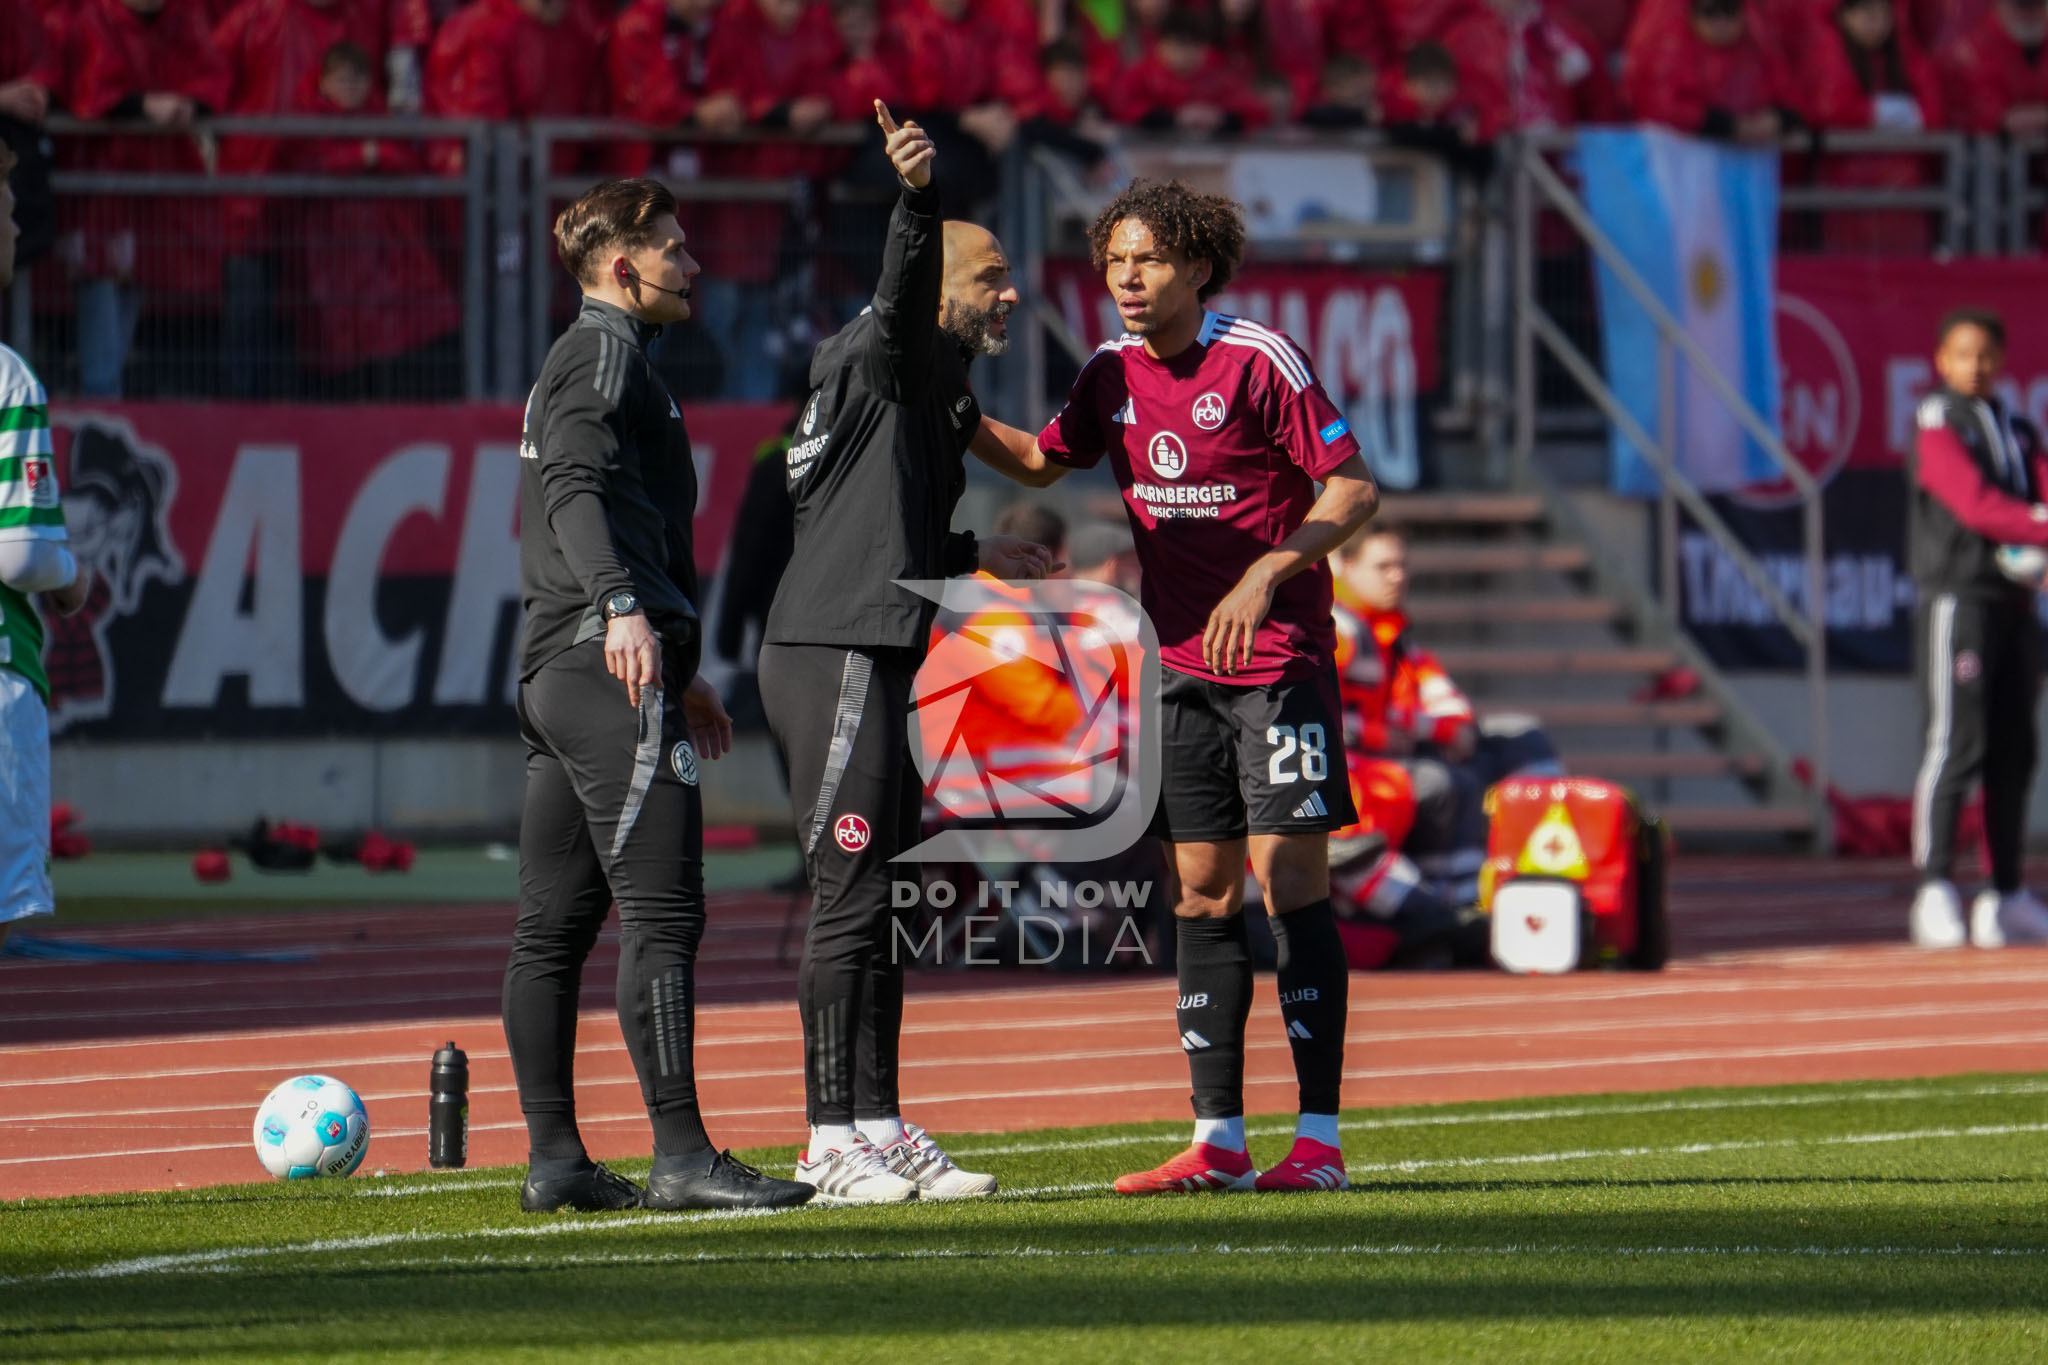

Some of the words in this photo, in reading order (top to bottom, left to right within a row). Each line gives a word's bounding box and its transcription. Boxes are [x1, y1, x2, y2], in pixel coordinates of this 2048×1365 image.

[1196, 407, 1222, 422] FCN
[1146, 504, 1219, 519] VERSICHERUNG
[1266, 723, 1328, 785] 28
[838, 828, 866, 844] FCN
[1176, 992, 1209, 1010] LUB
[1279, 987, 1319, 1006] CLUB
[327, 1119, 368, 1175] DERBYSTAR
